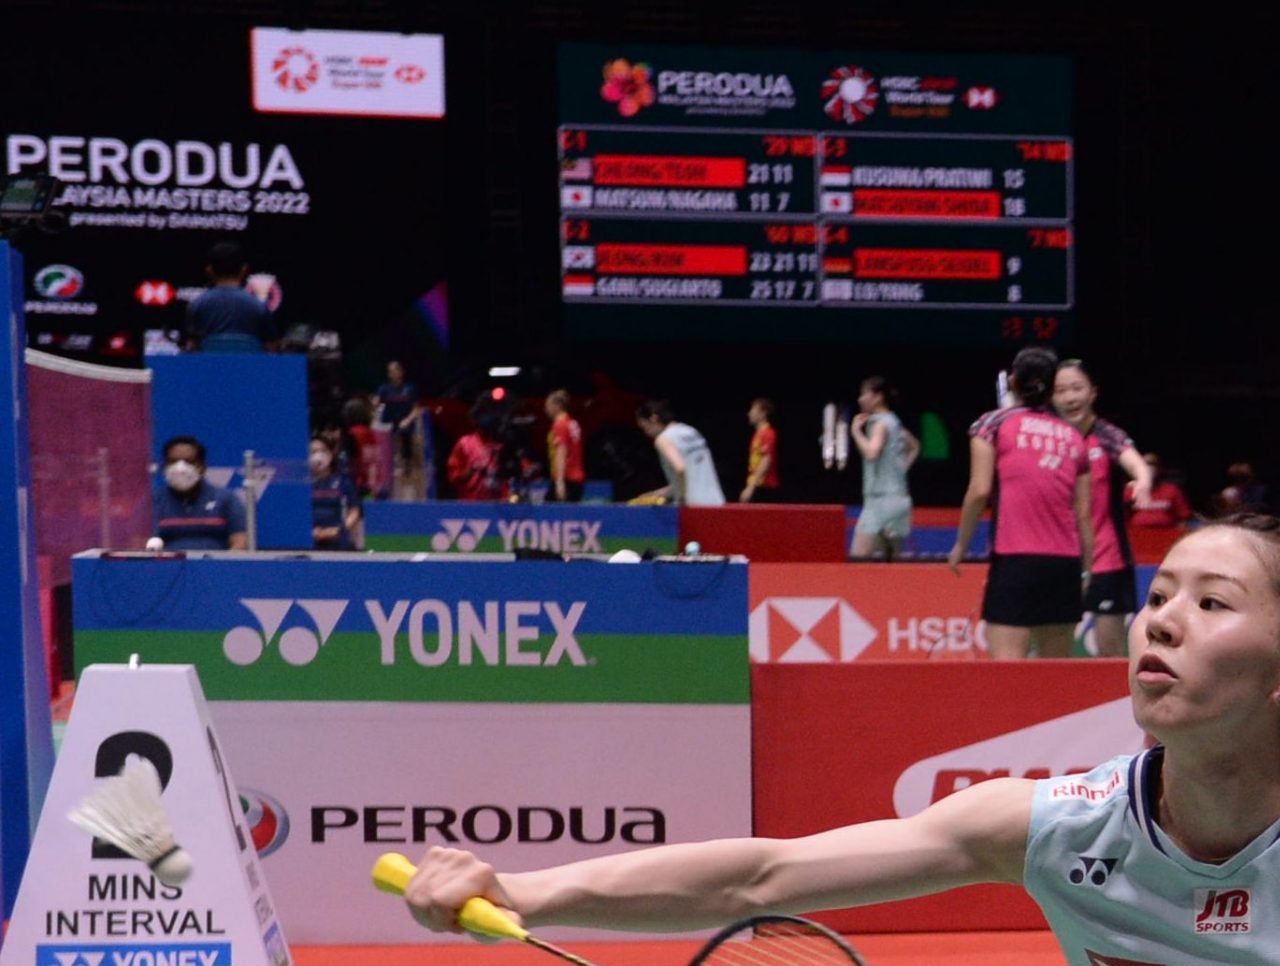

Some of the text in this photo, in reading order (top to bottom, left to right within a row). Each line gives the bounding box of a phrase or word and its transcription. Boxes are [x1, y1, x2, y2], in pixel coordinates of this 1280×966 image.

[658, 70, 795, 98] PERODUA
[7, 133, 305, 190] PERODUA
[52, 185, 311, 215] AYSIA MASTERS 2022
[497, 519, 602, 553] YONEX
[365, 598, 588, 667] YONEX
[87, 873, 184, 902] MINS
[1196, 889, 1249, 923] JTB
[45, 910, 226, 936] INTERVAL
[1196, 921, 1249, 933] SPORTS
